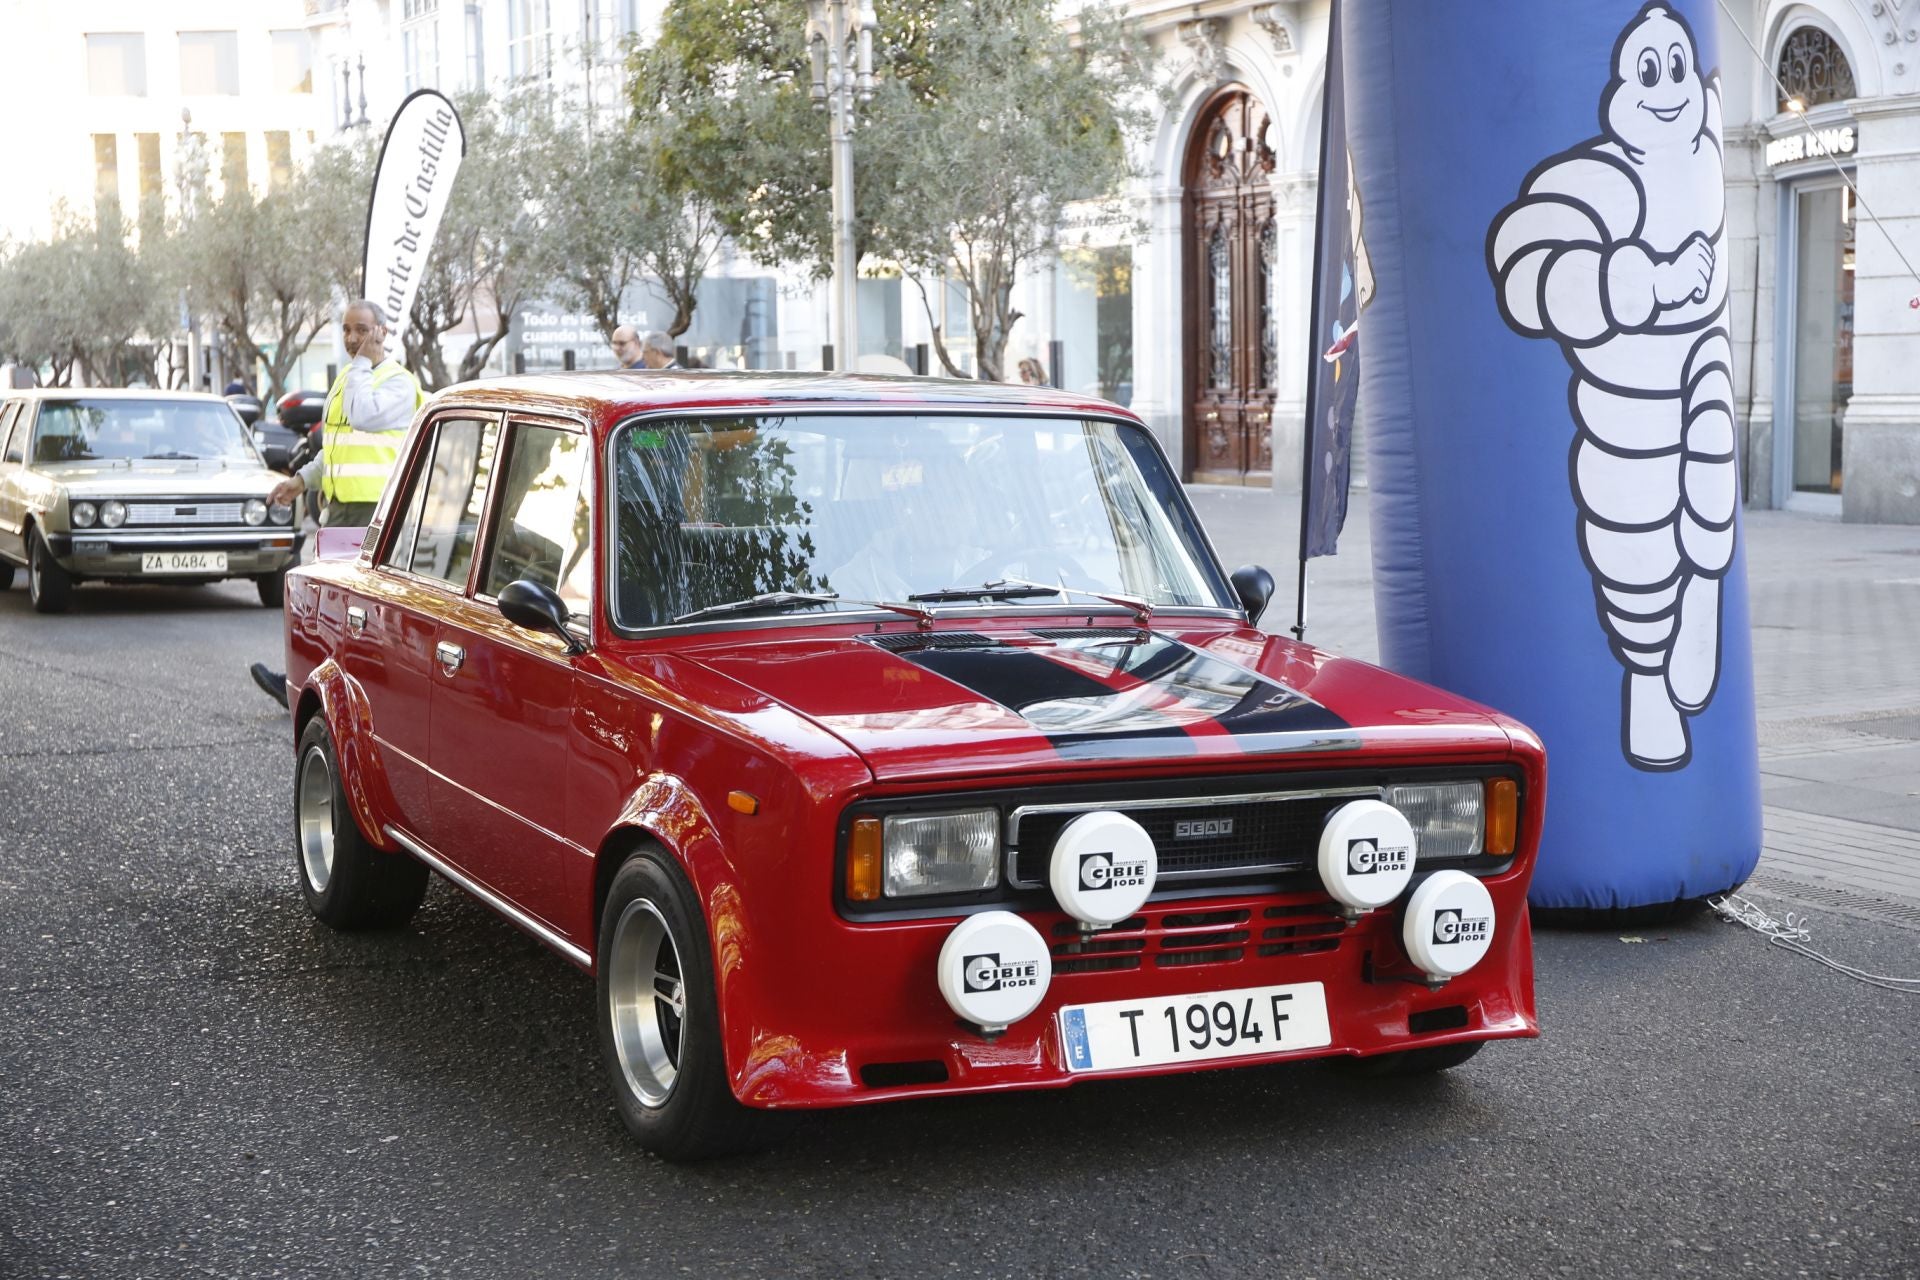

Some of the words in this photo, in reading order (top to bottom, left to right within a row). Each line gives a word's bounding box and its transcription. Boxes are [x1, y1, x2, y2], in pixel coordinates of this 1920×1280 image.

[1806, 127, 1854, 157] KING
[404, 108, 452, 219] Castilla
[393, 221, 421, 253] de
[521, 311, 558, 326] Todo
[522, 330, 577, 343] cuando
[145, 555, 163, 569] ZA
[172, 554, 206, 569] 0484
[216, 554, 225, 568] C
[1177, 821, 1232, 835] SEAT
[1359, 851, 1406, 864] CIBIE
[1092, 865, 1145, 879] CIBIE
[1378, 863, 1406, 871] IODE
[1114, 878, 1145, 887] IODE
[1444, 922, 1487, 933] CIBIE
[1461, 933, 1486, 941] IODE
[978, 965, 1036, 980] CIBIE
[1002, 979, 1036, 988] IODE
[1119, 1009, 1144, 1057] T
[1163, 998, 1263, 1053] 1994
[1270, 993, 1293, 1041] F
[1074, 1046, 1084, 1060] E
